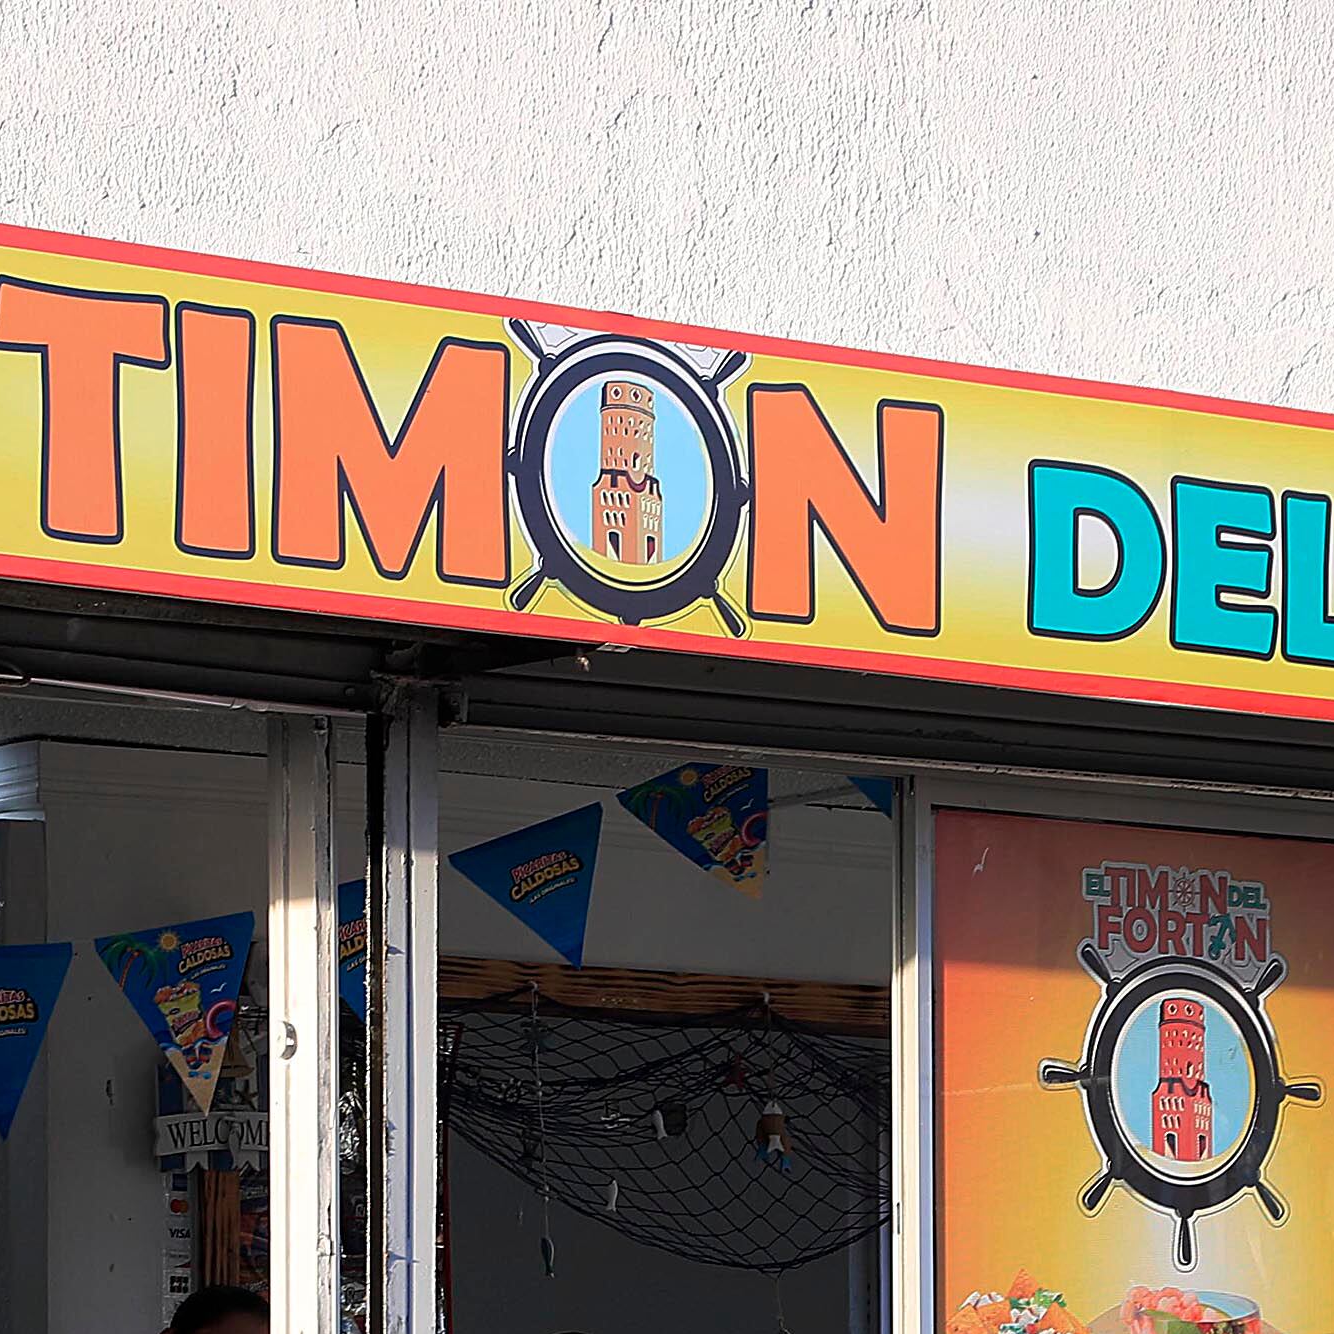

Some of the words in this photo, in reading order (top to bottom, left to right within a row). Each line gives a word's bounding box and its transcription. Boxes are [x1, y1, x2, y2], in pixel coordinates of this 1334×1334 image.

[511, 857, 580, 900] CALDOSAS
[1085, 873, 1110, 897] EL
[1228, 885, 1267, 909] DEL
[178, 944, 231, 974] CALDOSAS
[168, 1117, 268, 1147] WELCOM
[169, 1228, 192, 1239] VISA
